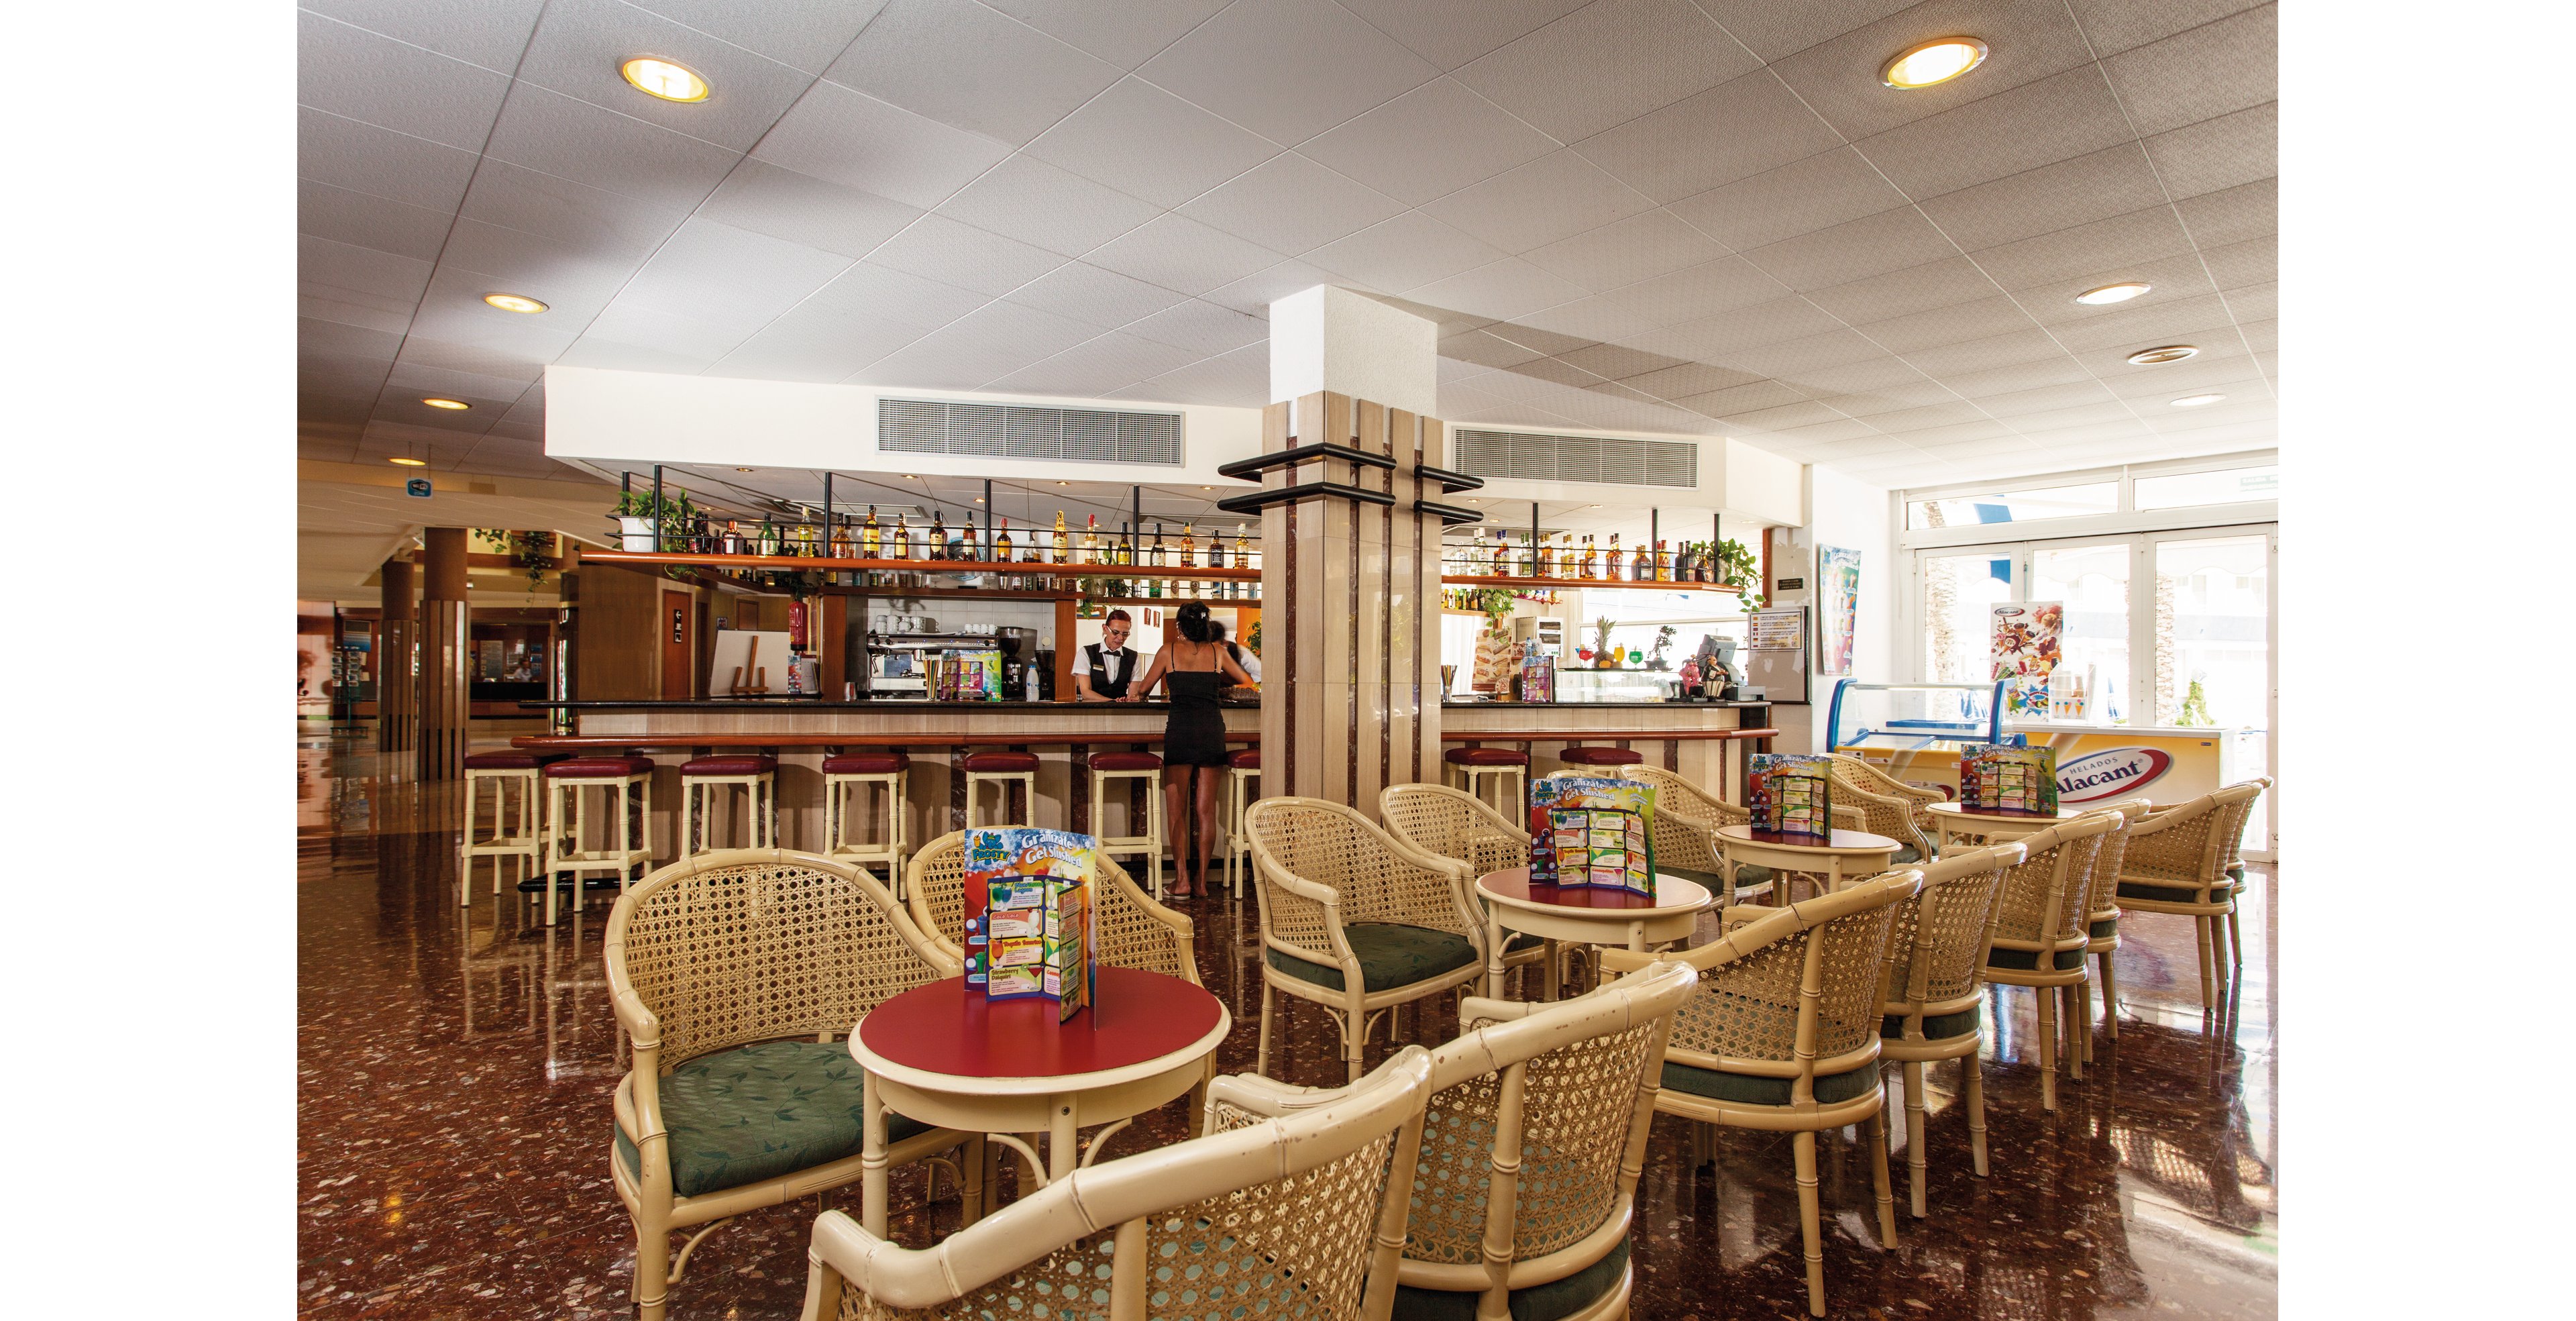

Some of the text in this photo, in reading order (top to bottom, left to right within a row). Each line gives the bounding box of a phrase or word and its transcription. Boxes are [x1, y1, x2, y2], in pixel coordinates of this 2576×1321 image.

[2070, 757, 2118, 774] HELADOS
[1565, 788, 1579, 801] Get
[1581, 788, 1615, 801] Slushed
[972, 849, 1011, 862] FROSTY
[1025, 846, 1082, 868] Get Slushed
